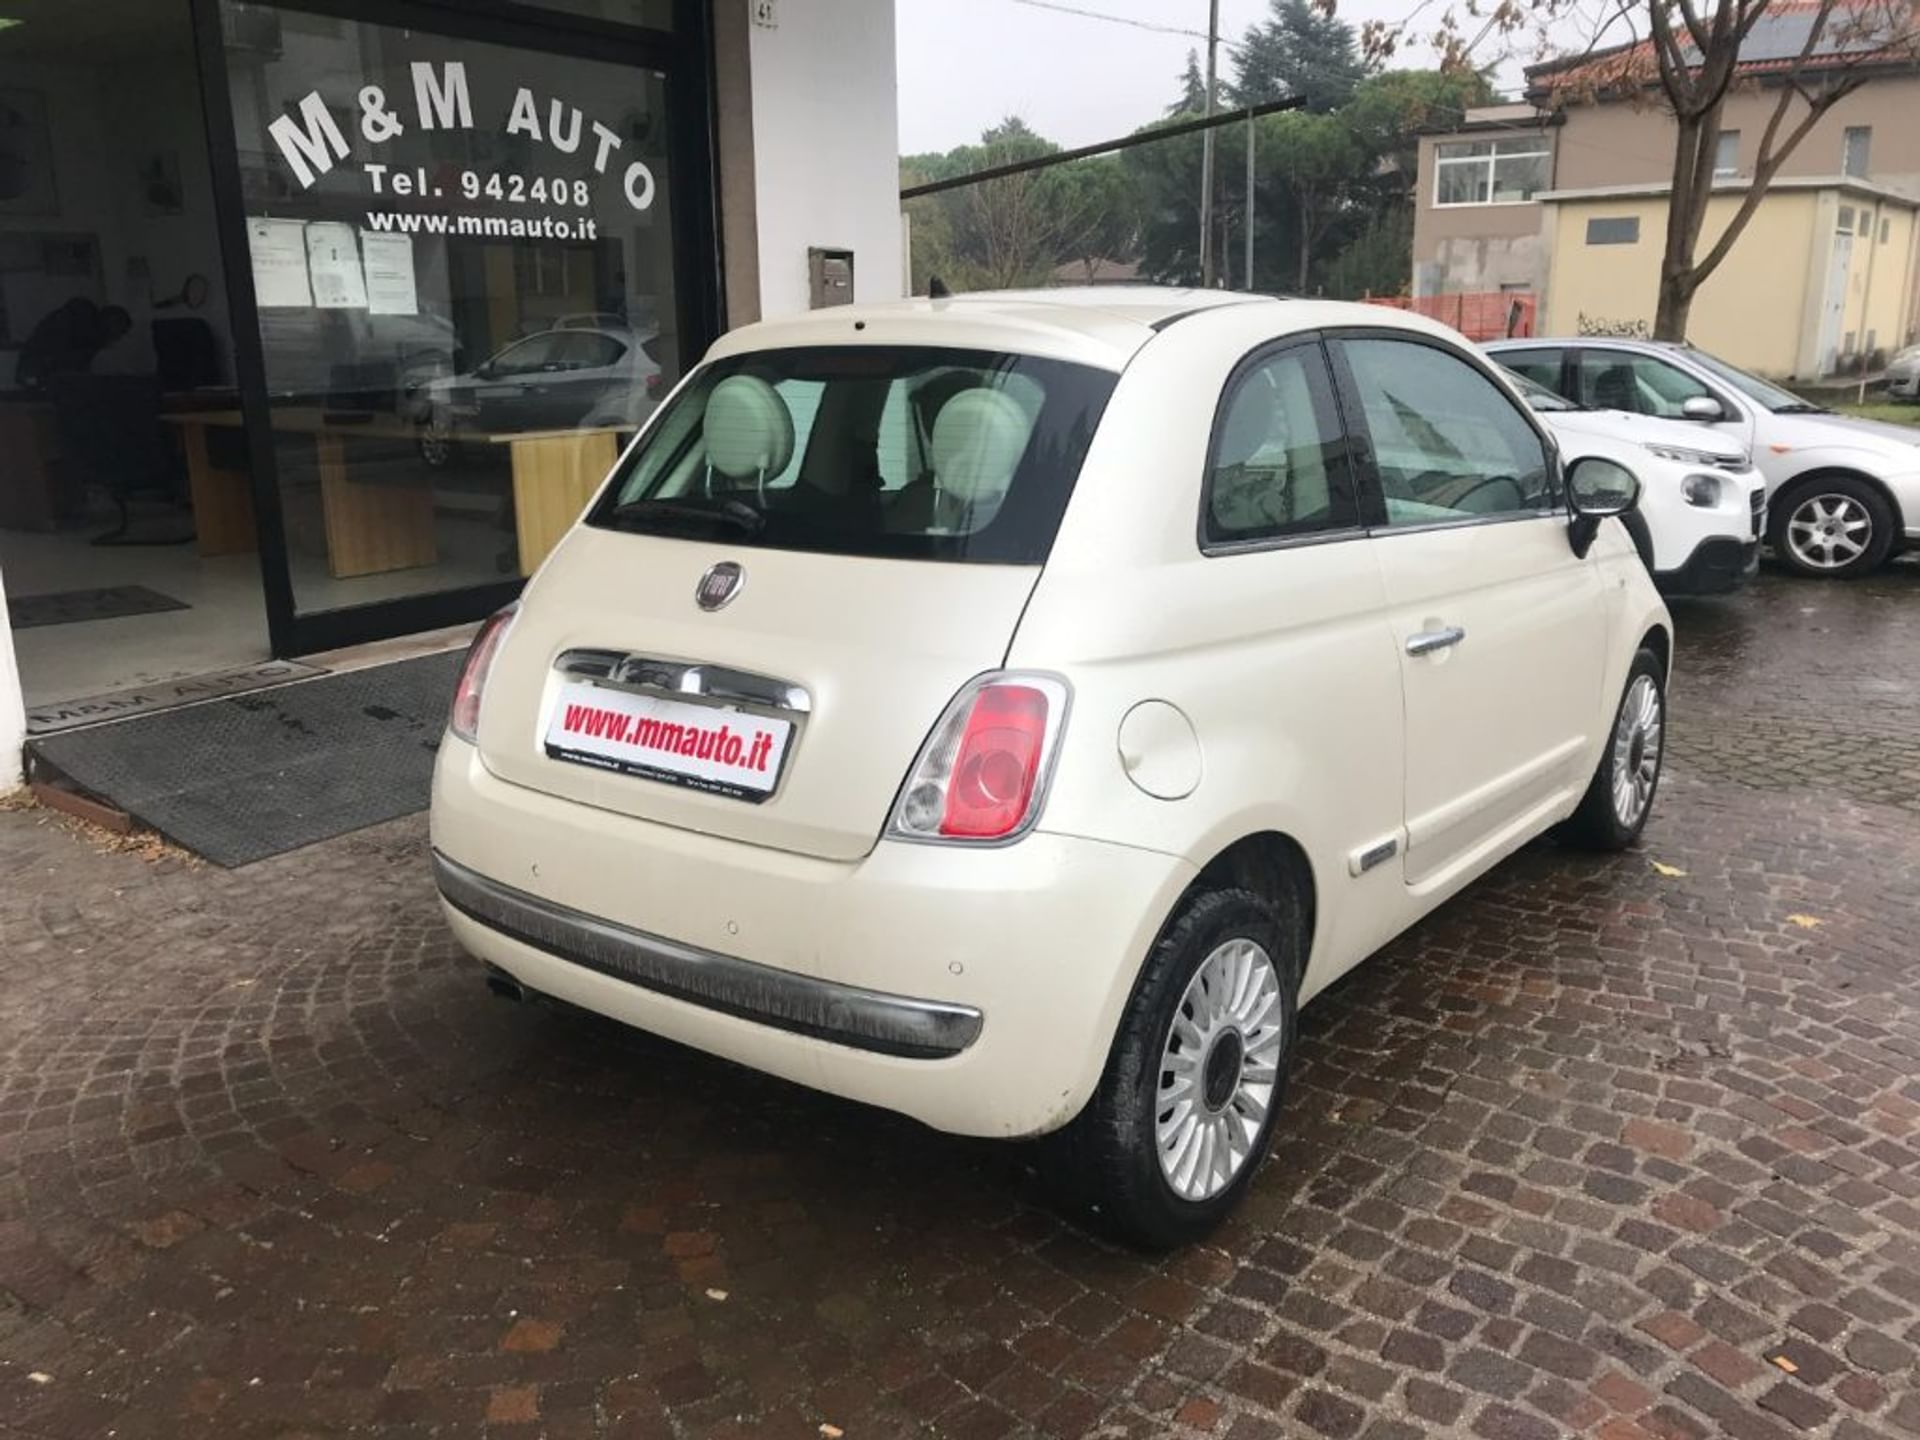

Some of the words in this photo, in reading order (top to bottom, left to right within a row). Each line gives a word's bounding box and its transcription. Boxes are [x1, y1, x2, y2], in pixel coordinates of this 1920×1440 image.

[506, 87, 656, 210] AUTO
[364, 163, 443, 197] Tel.
[461, 170, 590, 207] 942408
[367, 211, 598, 241] www.mmauto.it
[174, 666, 293, 697] AUTO
[563, 703, 773, 772] www.mmauto.it
